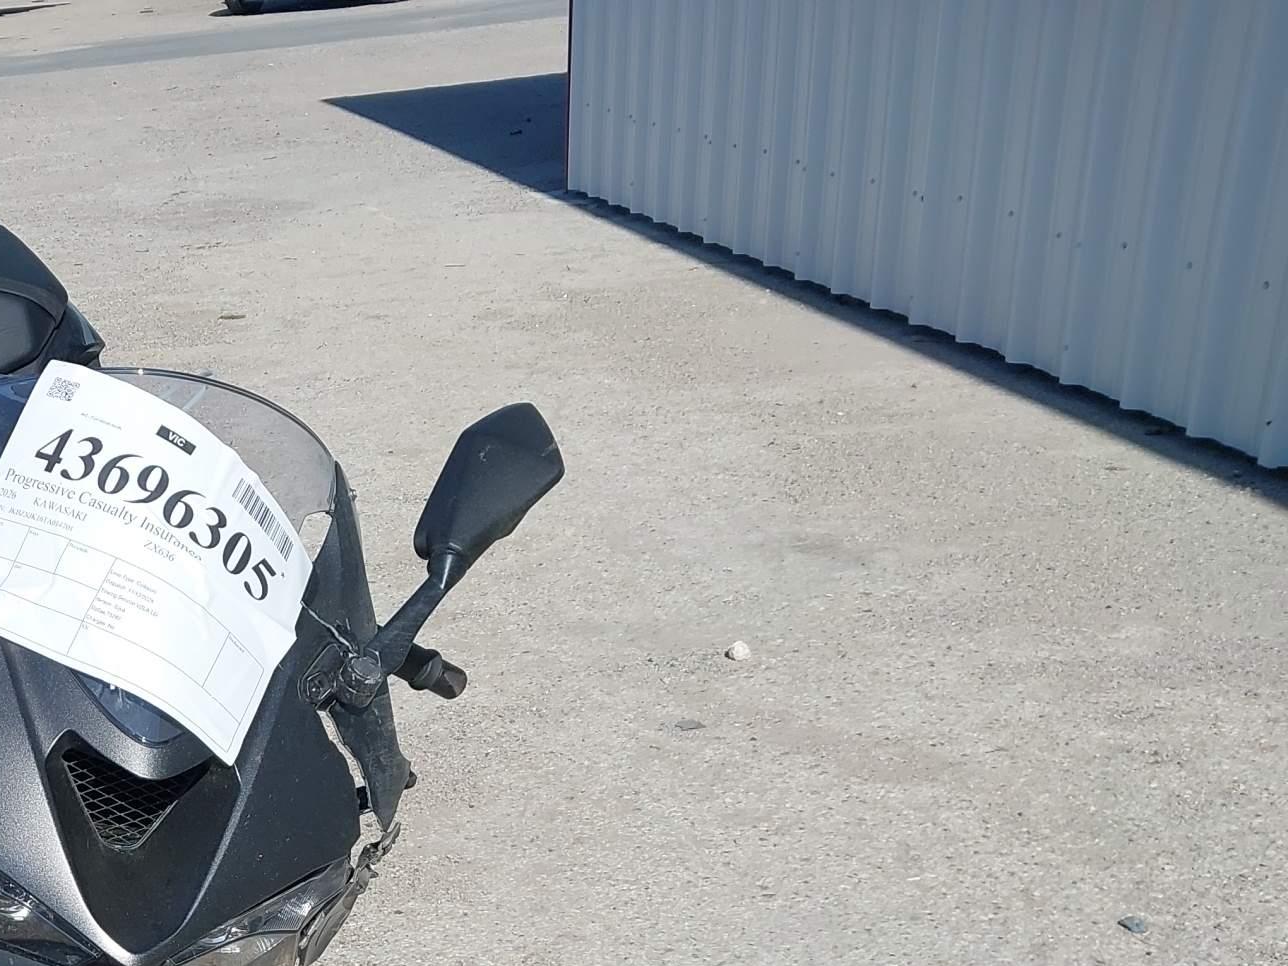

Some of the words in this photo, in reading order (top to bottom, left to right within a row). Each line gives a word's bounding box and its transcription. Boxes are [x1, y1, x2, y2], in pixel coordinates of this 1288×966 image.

[167, 431, 186, 447] VIC
[5, 468, 76, 500] Progressive
[78, 490, 139, 525] Casualty
[34, 428, 277, 601] 43696305
[33, 497, 88, 522] KAWASAKI
[143, 541, 176, 562] ZX636
